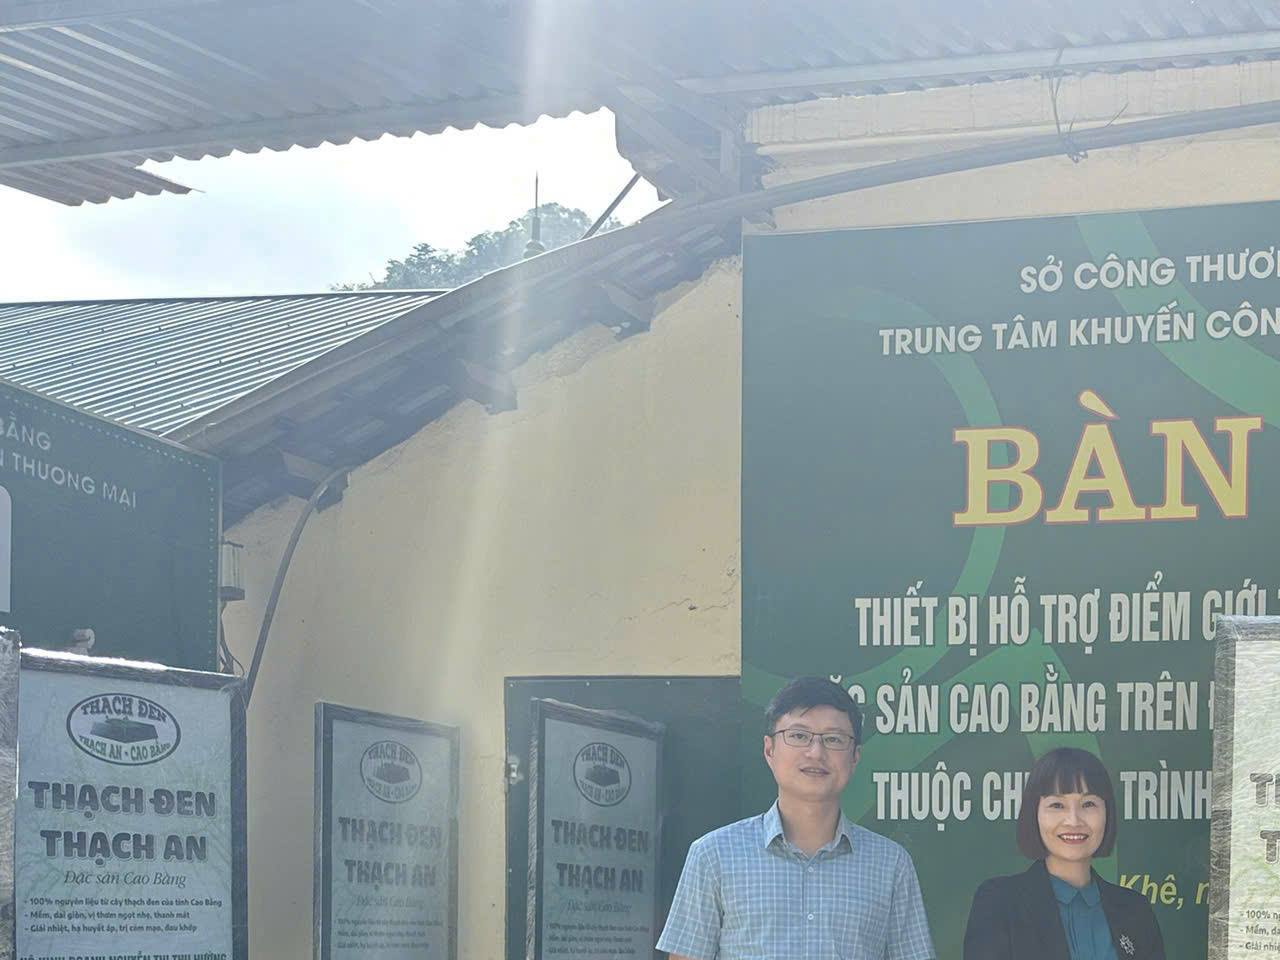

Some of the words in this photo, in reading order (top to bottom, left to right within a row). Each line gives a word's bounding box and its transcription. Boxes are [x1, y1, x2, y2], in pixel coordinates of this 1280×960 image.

[1019, 255, 1064, 294] SỞ
[1074, 253, 1176, 290] CÔNG
[879, 325, 983, 356] TRUNG
[992, 314, 1058, 350] TÂM
[1069, 300, 1195, 347] KHUYẾN
[952, 388, 1264, 528] BÀN
[855, 581, 939, 647] THIẾT
[948, 595, 978, 657] BỊ
[988, 575, 1031, 645] HỖ
[1039, 587, 1101, 655] TRỢ
[1108, 570, 1191, 643] ĐIỂM
[875, 667, 939, 735] SẢN
[948, 683, 1010, 734] CAO
[1020, 663, 1106, 733] BẰNG
[1116, 670, 1199, 732] TRÊN
[28, 781, 145, 819] THẠCH
[150, 788, 216, 817] ĐEN
[872, 761, 972, 832] THUỘC
[1120, 759, 1212, 821] TRÌNH
[40, 830, 155, 866] THẠCH
[163, 835, 207, 861] AN
[123, 872, 150, 885] Cao
